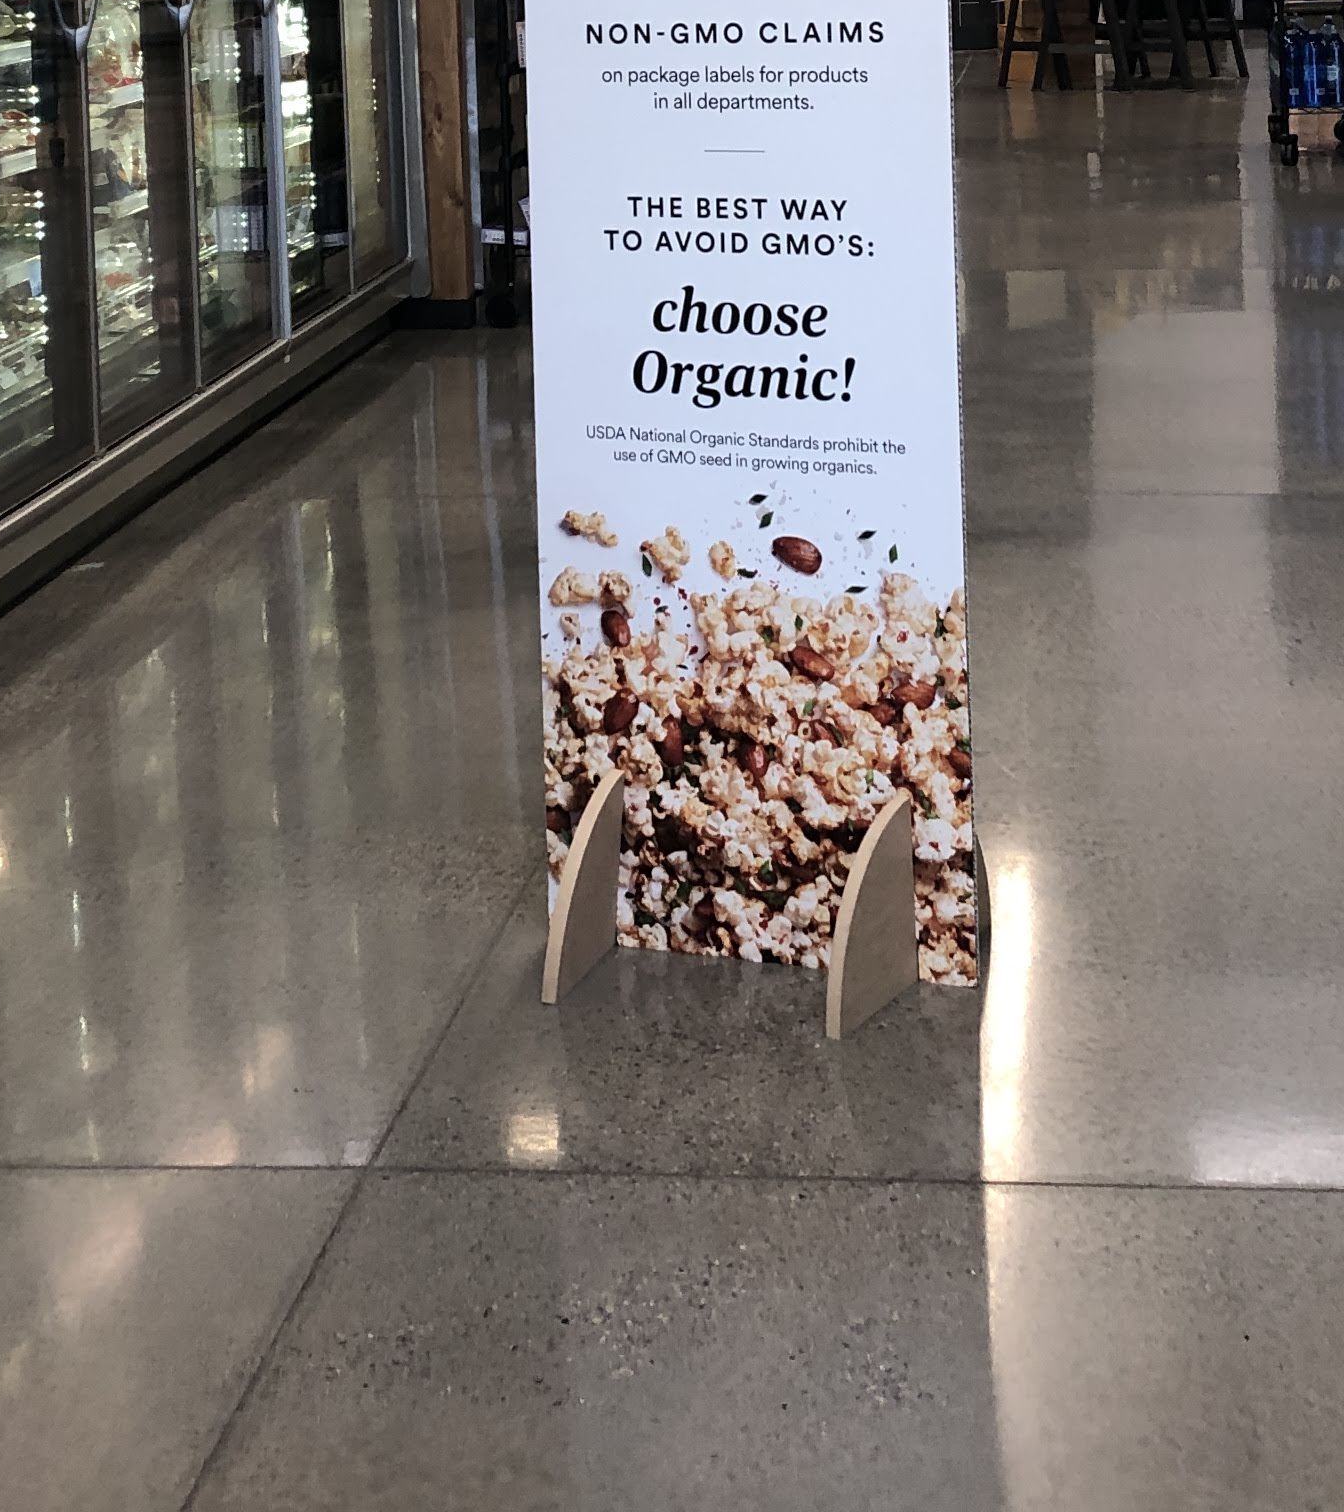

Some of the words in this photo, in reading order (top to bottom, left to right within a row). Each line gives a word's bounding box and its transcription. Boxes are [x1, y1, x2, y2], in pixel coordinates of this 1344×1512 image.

[586, 22, 744, 45] NON-GMO
[758, 21, 884, 44] CLAIMS
[601, 70, 623, 83] on
[628, 65, 700, 87] package
[705, 65, 755, 83] labels
[759, 65, 784, 83] for
[789, 65, 869, 87] products
[653, 91, 669, 109] in
[673, 91, 692, 110] all
[696, 92, 814, 114] departments.
[626, 196, 683, 219] THE
[696, 197, 768, 220] BEST
[780, 198, 848, 222] WAY
[603, 229, 643, 252] TO
[655, 230, 749, 254] AVOID
[652, 285, 828, 338] choose
[632, 350, 856, 409] Organic!
[586, 425, 627, 441] USDA
[629, 426, 686, 443] National
[689, 429, 745, 448] Organic
[748, 432, 820, 450] Standards
[823, 437, 879, 454] prohibit
[882, 439, 906, 455] the
[613, 451, 637, 462] use
[639, 448, 654, 463] of
[656, 449, 696, 465] GMO
[699, 452, 732, 467] seed
[735, 452, 748, 468] in
[751, 455, 809, 475] growing
[812, 459, 877, 476] organics.
